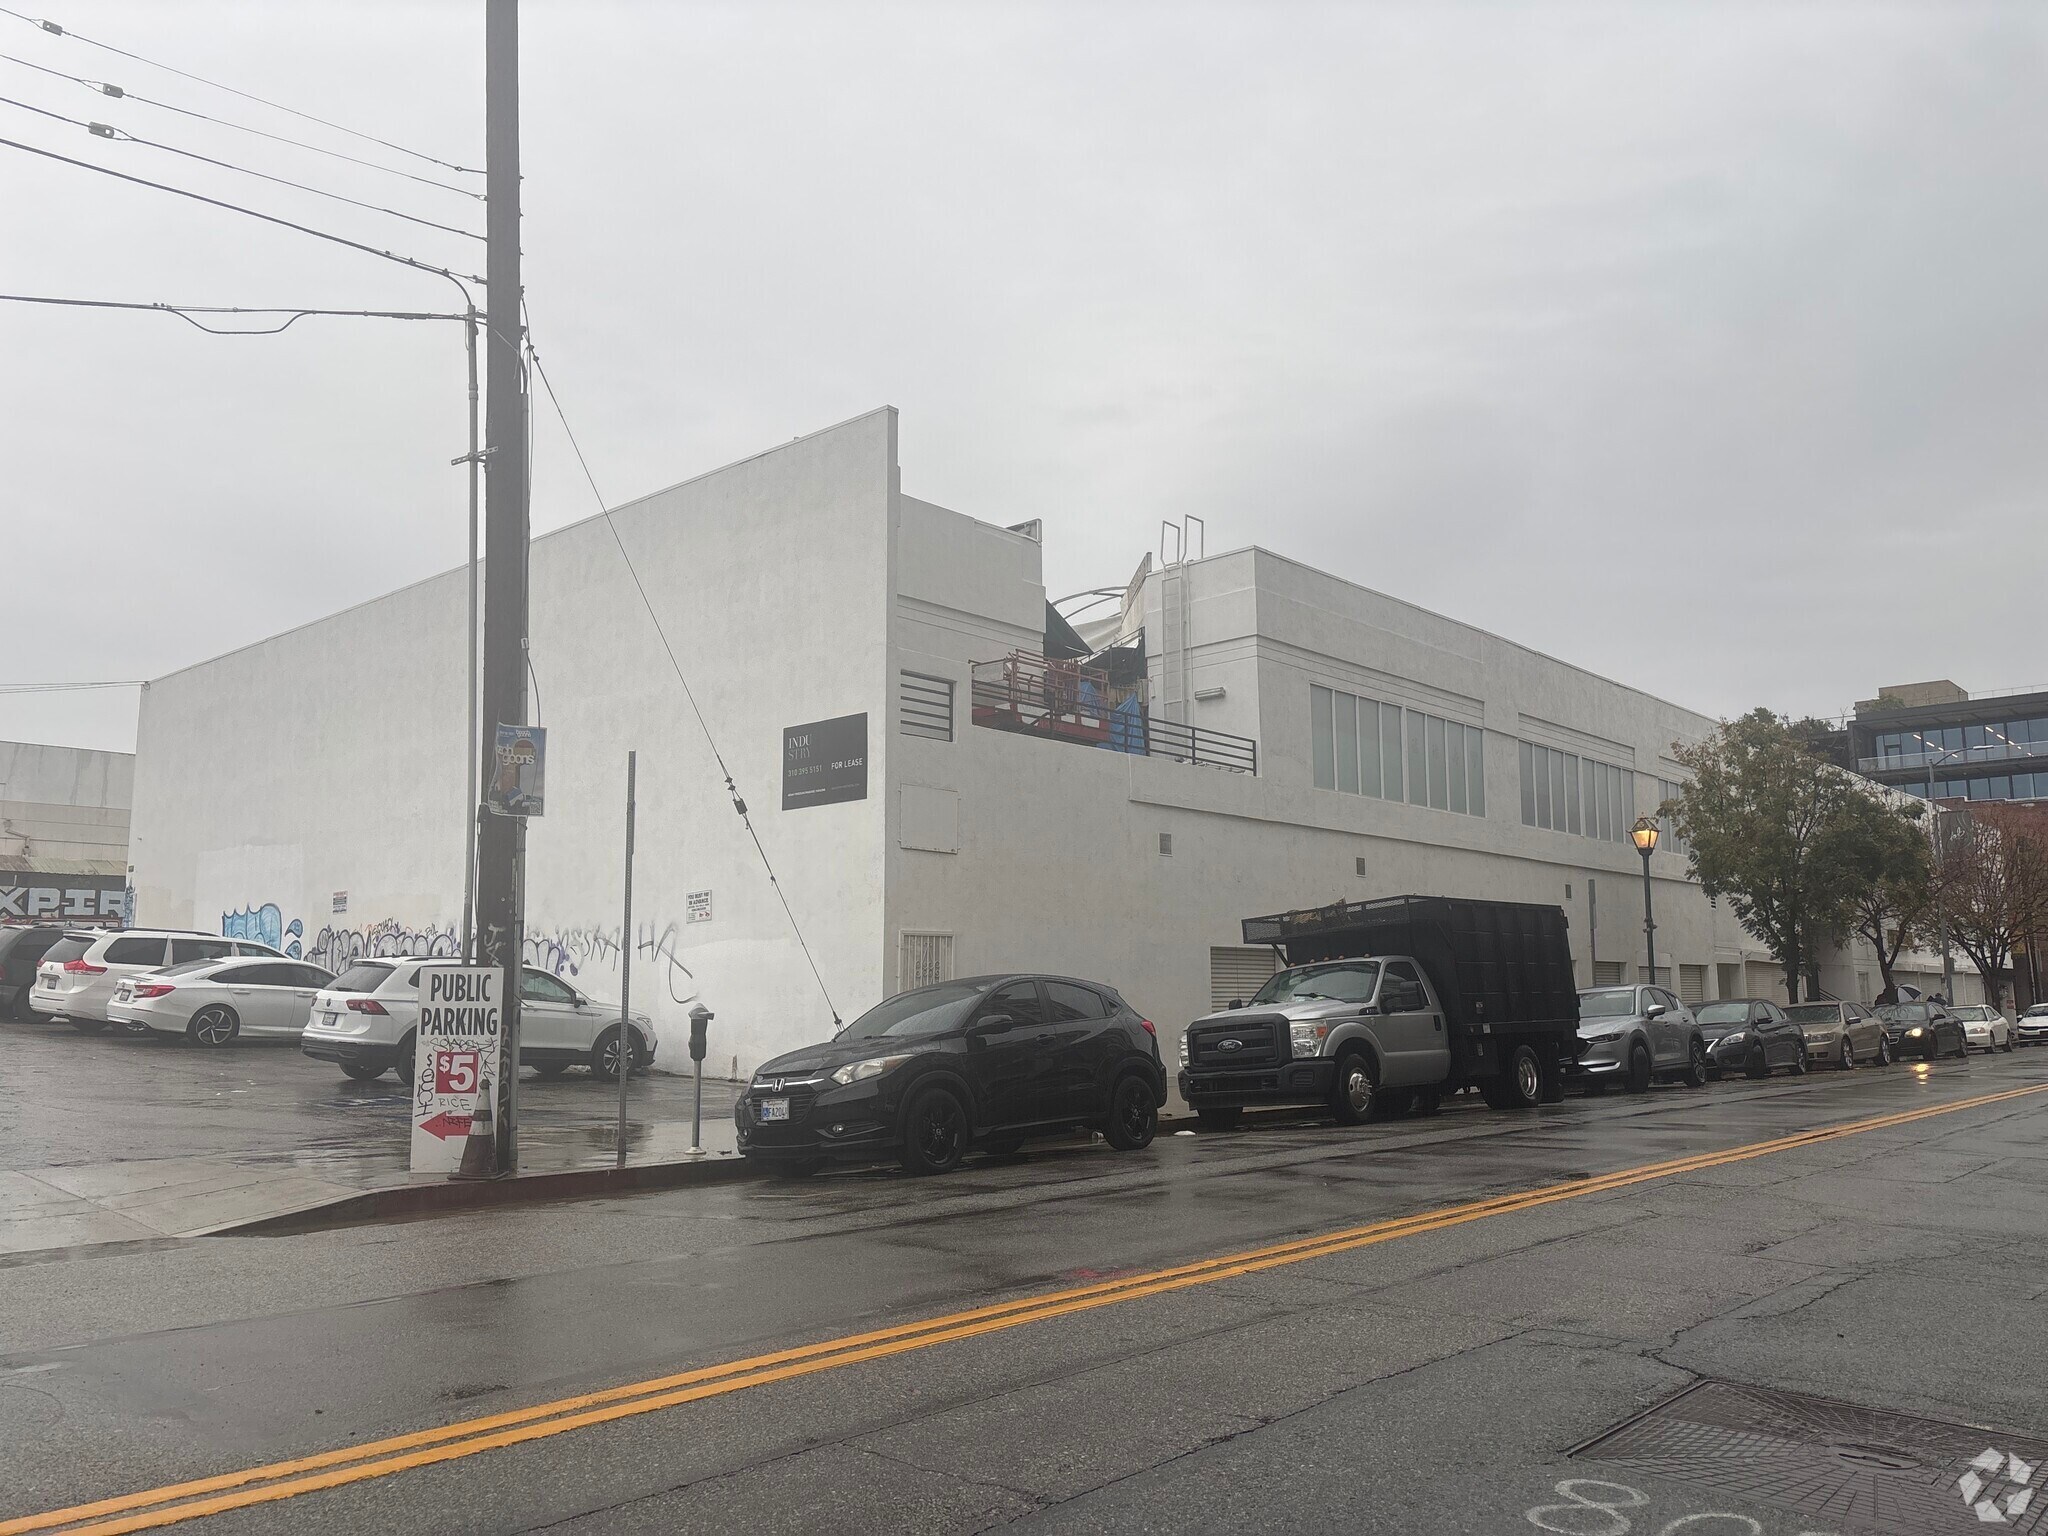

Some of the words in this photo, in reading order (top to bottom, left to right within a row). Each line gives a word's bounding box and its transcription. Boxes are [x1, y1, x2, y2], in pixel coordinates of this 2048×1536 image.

[788, 734, 811, 749] INDU
[788, 747, 810, 760] STRY
[788, 769, 797, 777] 310
[798, 766, 809, 776] 395
[810, 764, 822, 774] 5151
[831, 761, 843, 770] FOR
[844, 757, 863, 768] LEASE
[430, 973, 492, 1002] PUBLIC
[420, 1007, 498, 1036] PARKING
[439, 1054, 475, 1092] $5
[438, 1097, 472, 1111] RICE
